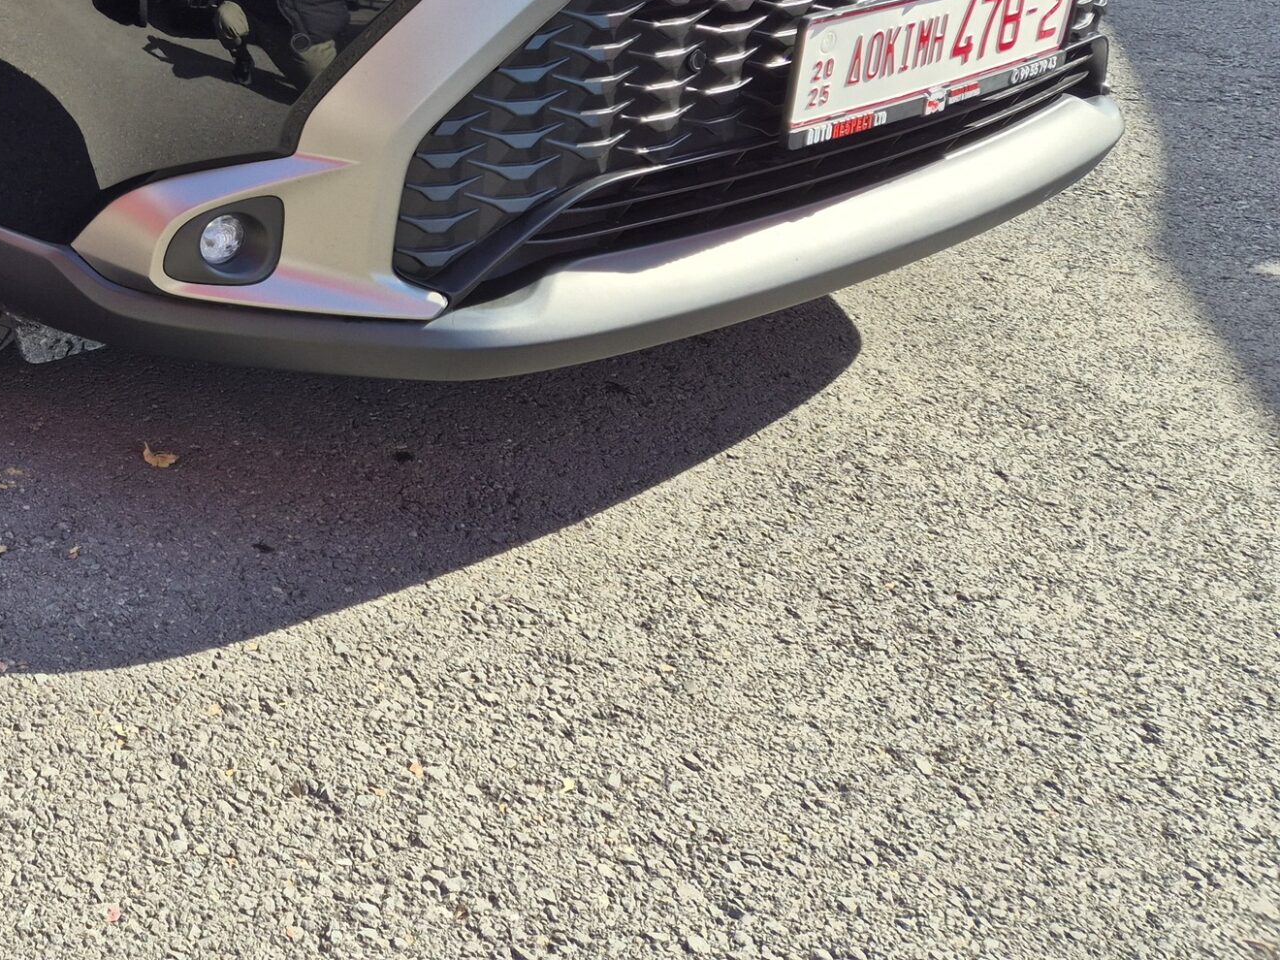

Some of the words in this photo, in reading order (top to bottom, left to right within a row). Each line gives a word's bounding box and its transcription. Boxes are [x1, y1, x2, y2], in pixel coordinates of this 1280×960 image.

[812, 58, 835, 84] 20
[808, 84, 830, 109] 25
[873, 110, 887, 127] LTD
